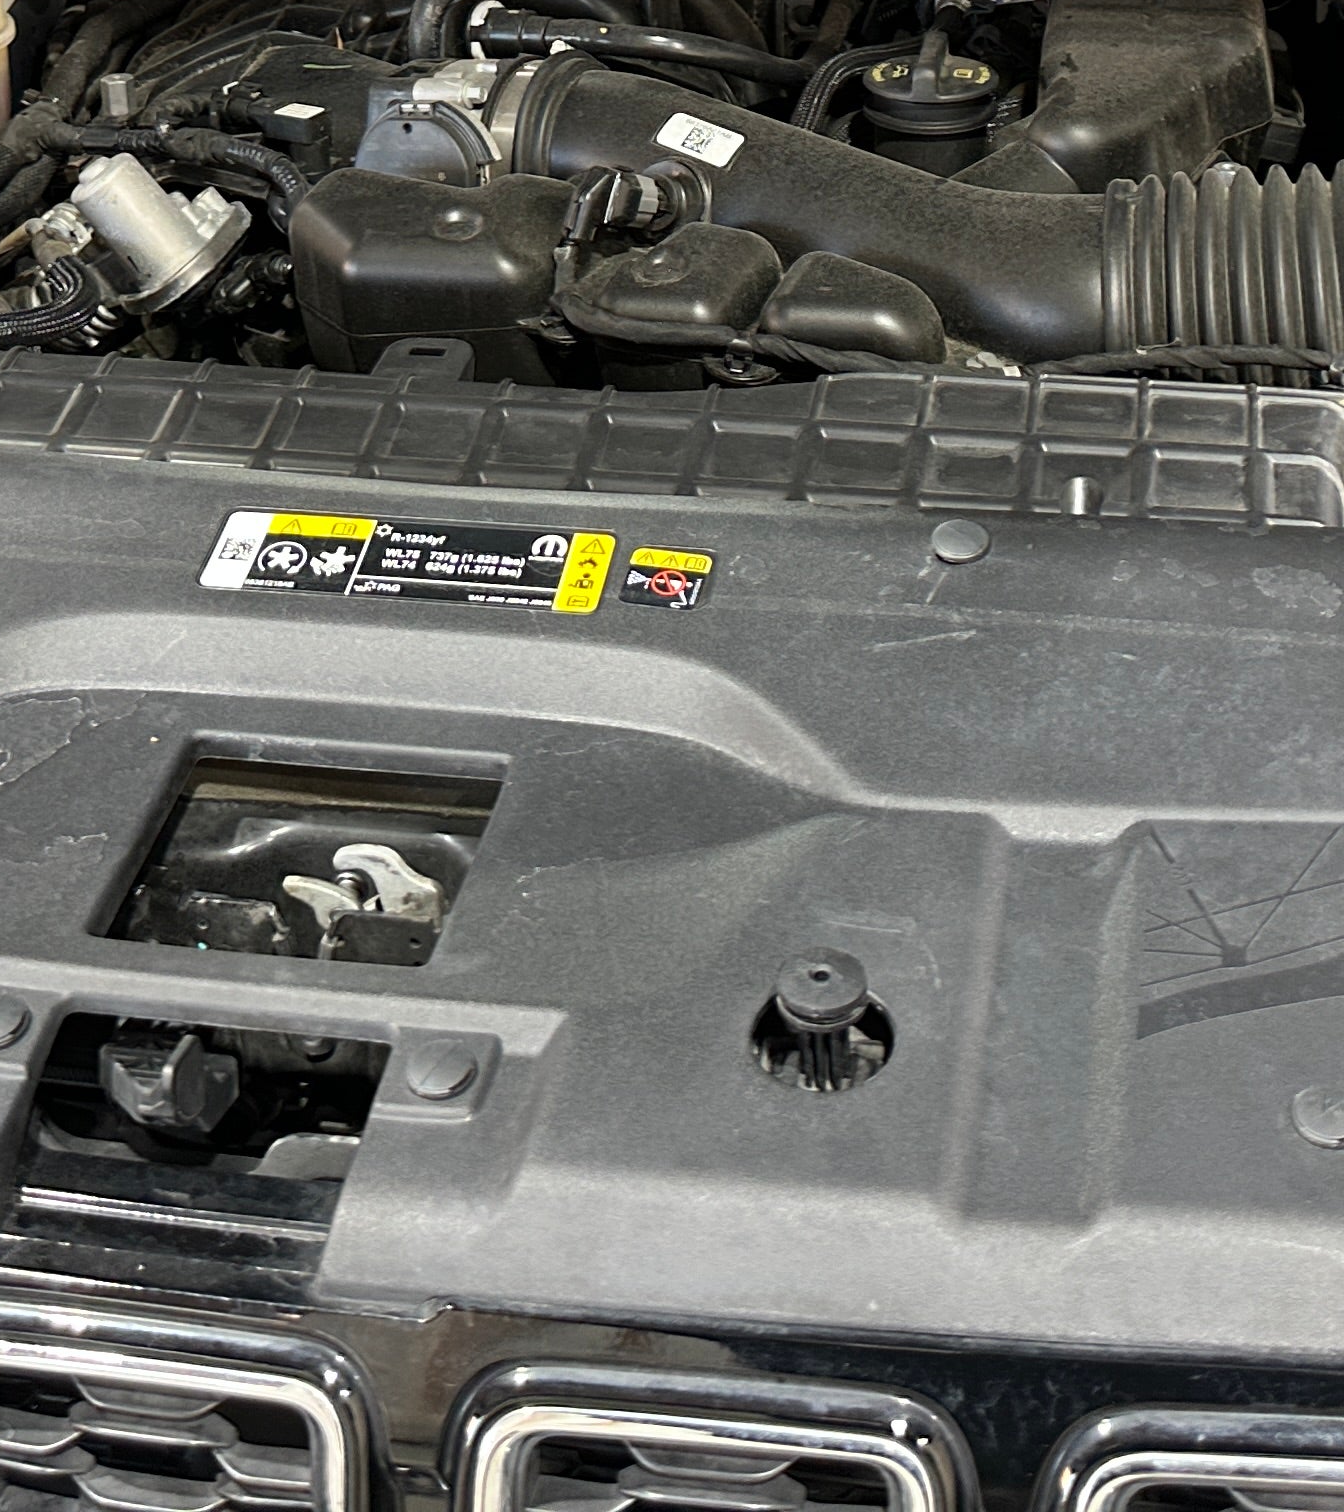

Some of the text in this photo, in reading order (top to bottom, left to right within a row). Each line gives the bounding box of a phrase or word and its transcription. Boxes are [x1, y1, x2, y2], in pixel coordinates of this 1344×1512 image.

[390, 533, 446, 546] R-1234yf
[430, 550, 459, 563] 737g
[381, 559, 416, 570] WL74
